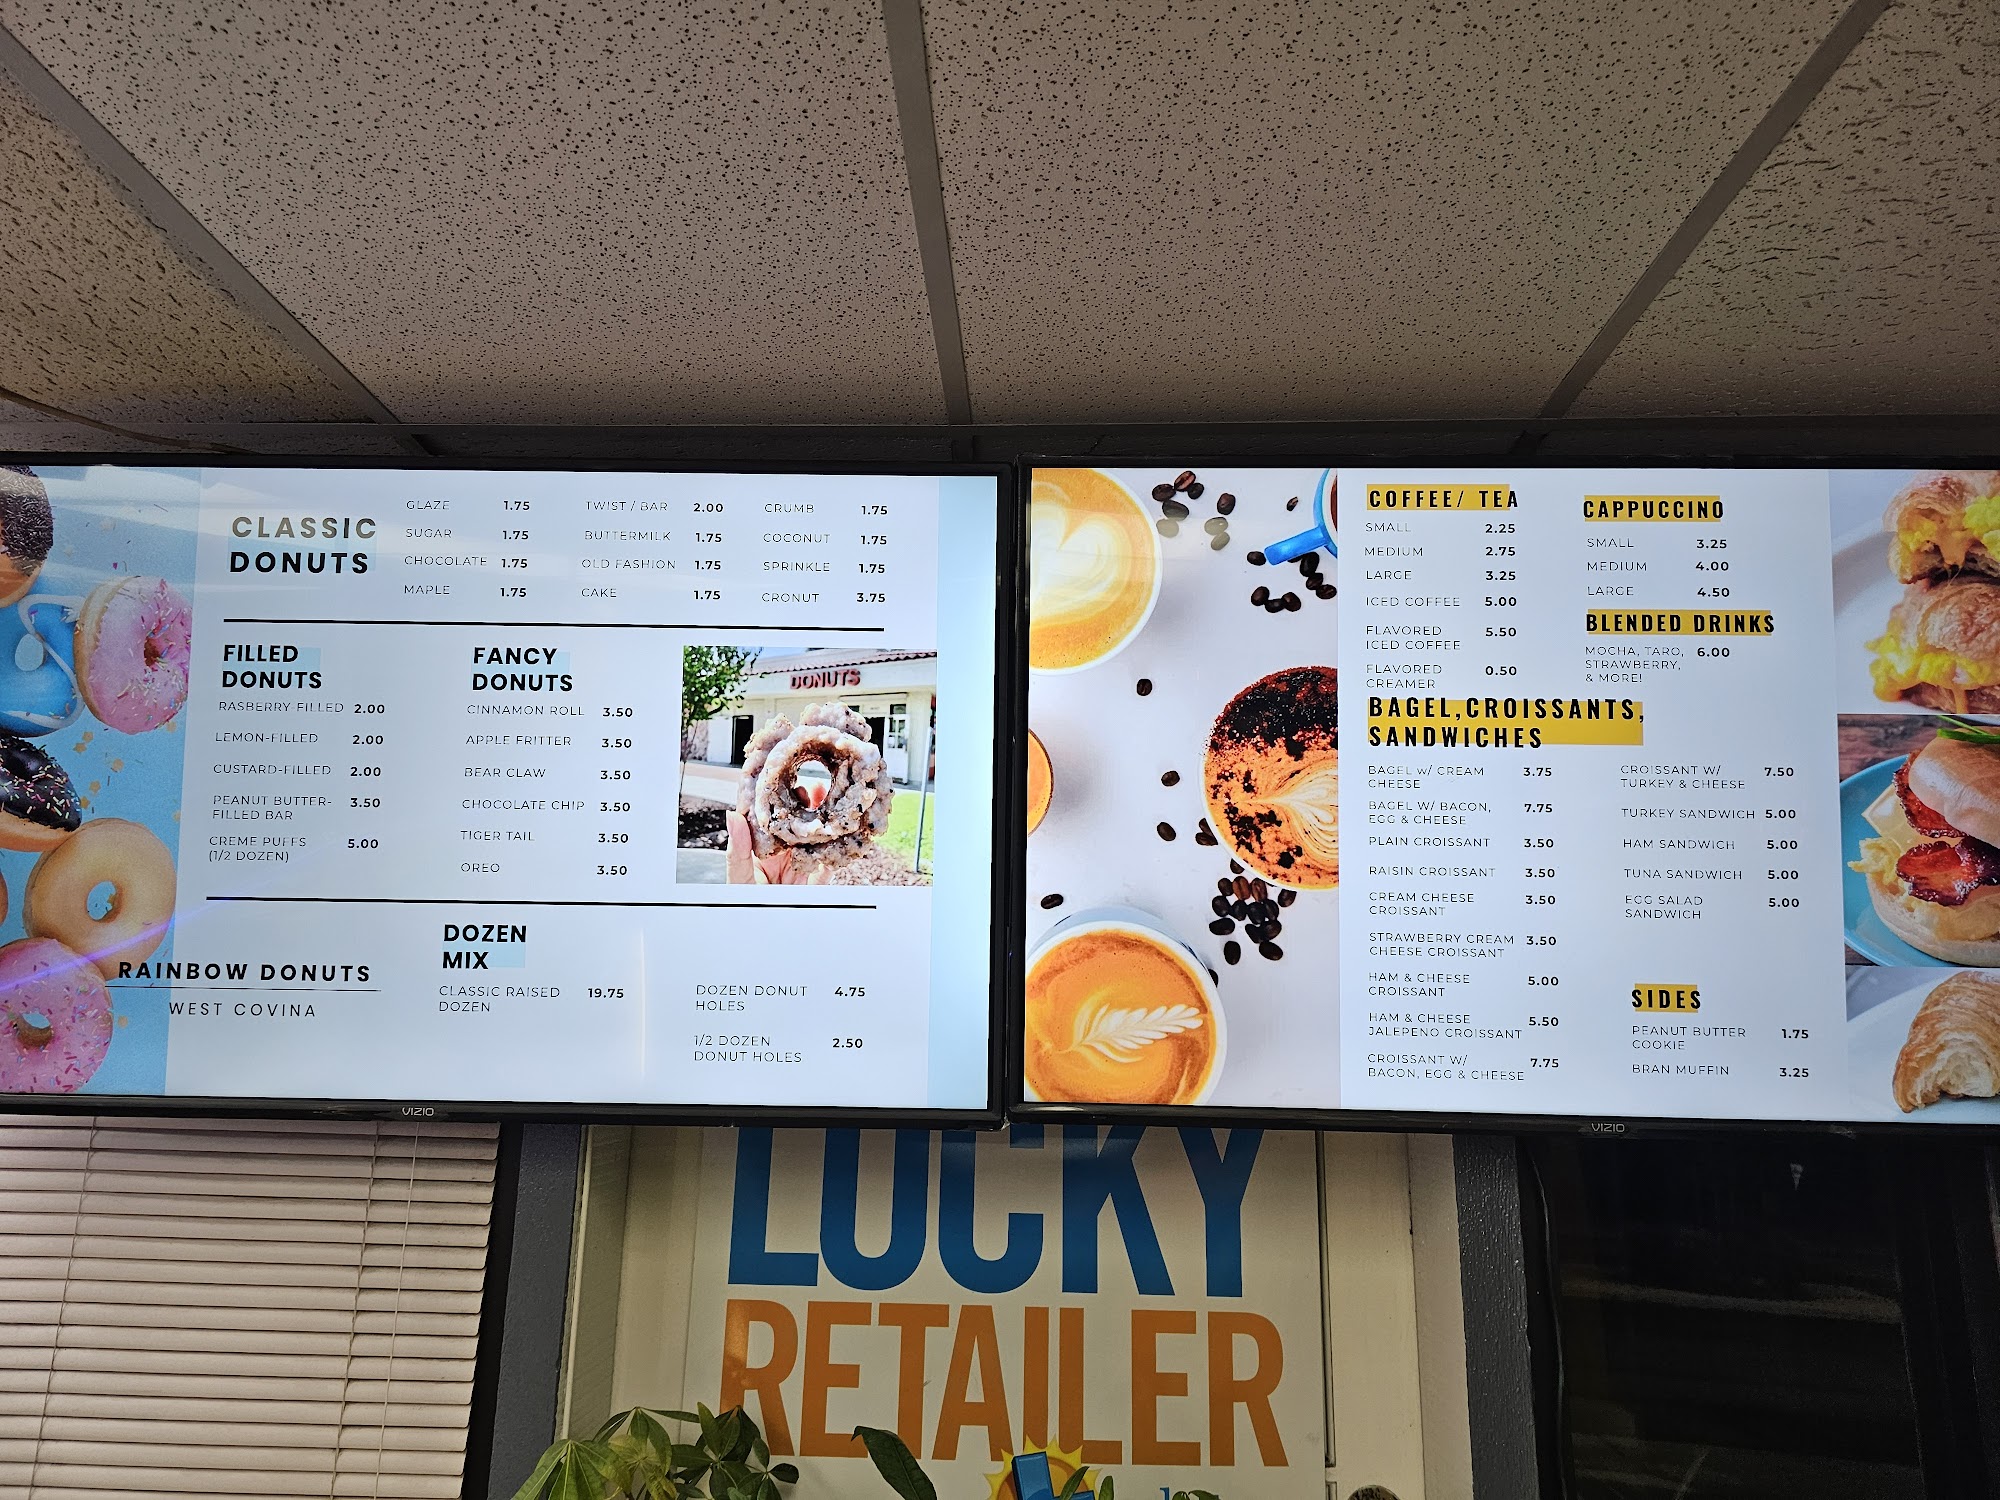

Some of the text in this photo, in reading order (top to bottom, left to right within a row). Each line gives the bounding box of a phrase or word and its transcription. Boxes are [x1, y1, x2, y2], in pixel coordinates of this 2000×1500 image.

[1479, 490, 1518, 508] TEA
[406, 500, 450, 510] GLAZE
[503, 501, 530, 511] 1.75
[693, 503, 723, 512] 2.00
[764, 503, 815, 513] CRUMB
[861, 505, 888, 515] 1.75
[1583, 500, 1723, 519] CAPPUCCINO
[232, 516, 376, 539] CLASSIC
[1365, 522, 1411, 532] SMALL
[1485, 524, 1515, 534] 2.25
[406, 529, 452, 539] SUGAR
[502, 530, 529, 540] 1.75
[585, 531, 671, 542] BUTTERMILK
[696, 532, 722, 543] 1.75
[763, 533, 831, 543] COCONUT
[860, 535, 888, 545] 1.75
[1586, 538, 1634, 548] SMALL
[1696, 539, 1727, 549] 3.25
[1365, 546, 1423, 557] MEDIUM
[1485, 546, 1516, 557] 2.75
[230, 552, 368, 574] DONUTS
[404, 556, 488, 566] CHOCOLATE
[501, 558, 528, 568] 1.75
[582, 559, 676, 569] OLD FASHION
[695, 560, 721, 570] 1.75
[1587, 561, 1647, 572] MEDIUM
[1695, 561, 1729, 572] 4.00
[763, 562, 830, 572] SPRINKLE
[858, 563, 885, 574] 1.75
[1365, 570, 1412, 580] LARGE
[1485, 570, 1516, 581] 3.25
[404, 585, 450, 595] MAPLE
[500, 587, 527, 597] 1.75
[582, 588, 617, 598] CAKE
[694, 590, 720, 600] 1.75
[1587, 586, 1634, 596] LARGE
[1697, 587, 1730, 597] 4.50
[762, 592, 819, 603] CRONUT
[857, 592, 885, 603] 3.75
[1366, 597, 1460, 607] ICED COFFEE
[1485, 597, 1517, 607] 5.00
[1586, 614, 1774, 633] BLENDED DRINKS
[1366, 625, 1442, 636] FLAVORED
[1485, 627, 1517, 637] 5.50
[1366, 640, 1461, 650] ICED COFFEE
[224, 645, 298, 662] FILLED
[474, 647, 557, 665] FANCY
[1697, 647, 1730, 657] 6.00
[1366, 664, 1442, 674] FLAVORED
[1485, 665, 1517, 676] 0.50
[1585, 660, 1681, 671] STRAWBERRY,
[222, 671, 322, 689] DONUTS
[472, 674, 573, 692] DONUTS
[790, 668, 861, 690] DONUTS
[1366, 678, 1436, 689] CREAMER
[354, 704, 385, 714] 2.00
[467, 705, 584, 716] CINNAMON ROLL
[603, 707, 633, 717] 3.50
[215, 733, 318, 743] LEMON-FILLED
[352, 735, 383, 745] 2.00
[466, 735, 571, 746] APPLE FRITTER
[1369, 726, 1542, 748] SANDWICHES
[602, 739, 632, 748] 3.50
[213, 764, 331, 775] CUSTARD-FILLED
[350, 766, 381, 777] 2.00
[465, 768, 546, 778] BEAR CLAW
[600, 770, 631, 780] 3.50
[213, 796, 332, 807] PEANUT BUTTER-
[350, 798, 381, 808] 3.50
[462, 800, 585, 810] CHOCOLATE CHIP
[600, 802, 630, 812] 3.50
[213, 810, 293, 820] FILLED BAR
[1622, 808, 1755, 820] TURKEY SANDWICH
[1765, 809, 1796, 819] 5.00
[461, 830, 535, 841] TIGER TAIL
[598, 833, 628, 843] 3.50
[209, 836, 306, 847] CREME PUFFS
[348, 839, 379, 849] 5.00
[1369, 836, 1490, 847] PLAIN CROISSANT
[1524, 838, 1554, 849] 3.50
[1623, 839, 1735, 851] HAM SANDWICH
[1766, 840, 1797, 850] 5.00
[461, 863, 500, 873] OREO
[597, 866, 627, 876] 3.50
[1369, 866, 1496, 878] RAISIN CROISSANT
[1525, 868, 1555, 879] 3.50
[1624, 869, 1742, 880] TUNA SANDWICH
[1767, 870, 1799, 880] 5.00
[1369, 892, 1474, 903] CREAM CHEESE
[1525, 895, 1556, 906] 3.50
[1625, 895, 1703, 906] EGG SALAD
[1769, 897, 1799, 908] 5.00
[1369, 906, 1446, 916] CROISSANT
[1625, 909, 1701, 920] SANDWICH
[444, 924, 526, 943] DOZEN
[1369, 933, 1514, 945] STRAWBERRY CREAM
[1526, 935, 1556, 946] 3.50
[1369, 946, 1504, 958] CHEESE CROISSANT
[443, 951, 489, 969] MIX
[119, 962, 370, 982] RAINBOW DONUTS
[439, 986, 560, 998] CLASSIC RAISED
[588, 987, 624, 999] 19.75
[696, 985, 808, 997] DOZEN DONUT
[834, 986, 865, 998] 4.75
[1632, 989, 1701, 1010] SIDES
[169, 1002, 315, 1017] WEST COVINA
[439, 1001, 491, 1012] DOZEN
[696, 1000, 745, 1011] HOLES
[1632, 1026, 1746, 1038] PEANUT BUTTER
[1781, 1028, 1809, 1039] 1.75
[833, 1037, 863, 1049] 2.50
[1632, 1040, 1685, 1051] COOKIE
[694, 1051, 802, 1064] DONUT HOLES
[1632, 1064, 1729, 1076] BRAN MUFFIN
[1779, 1067, 1809, 1078] 3.25
[402, 1107, 434, 1116] VIZIO
[1591, 1123, 1625, 1133] VIZIO
[728, 1128, 1264, 1298] LUCKY
[718, 1299, 1289, 1467] RETAILER
